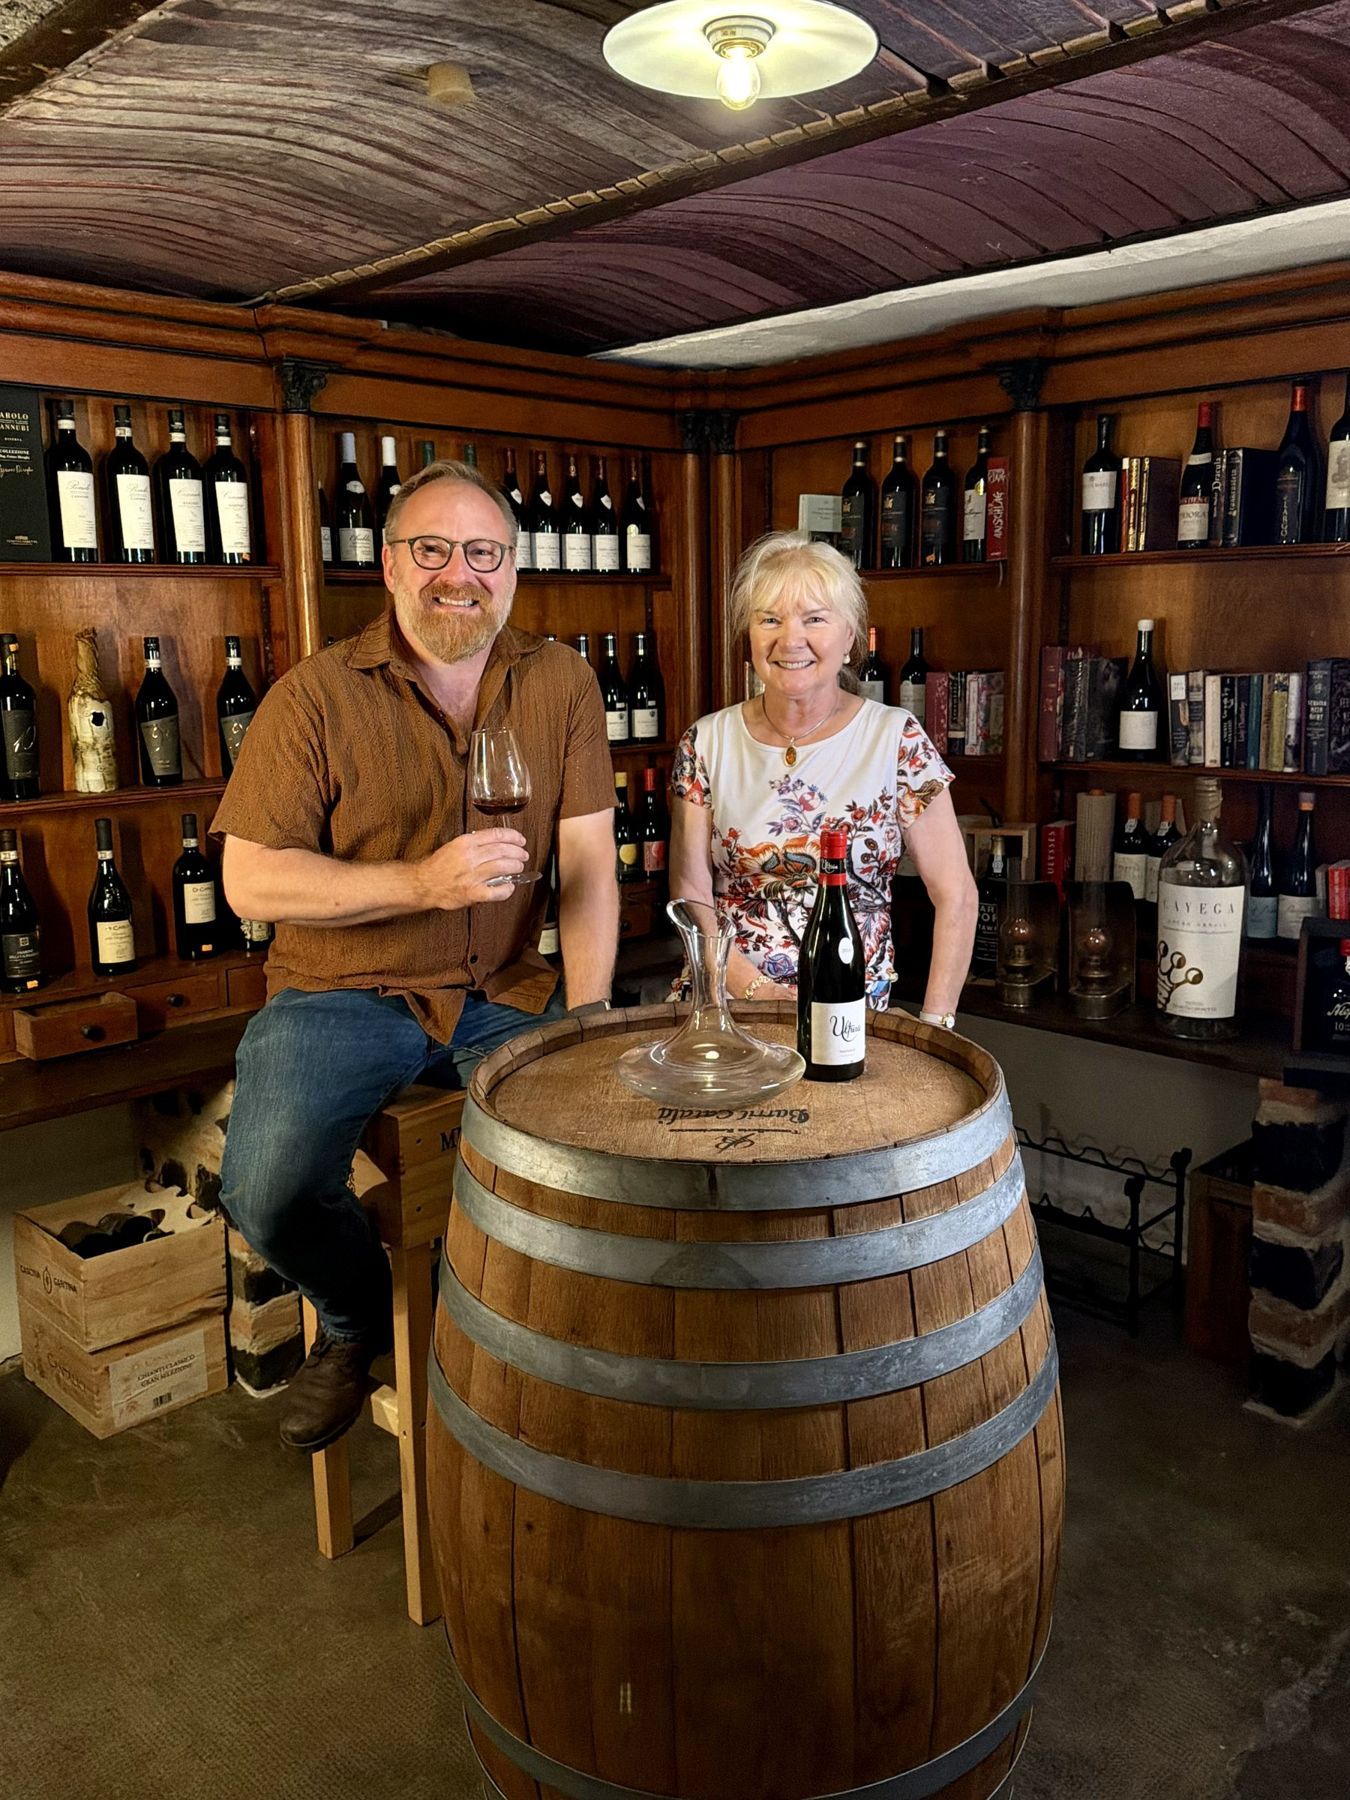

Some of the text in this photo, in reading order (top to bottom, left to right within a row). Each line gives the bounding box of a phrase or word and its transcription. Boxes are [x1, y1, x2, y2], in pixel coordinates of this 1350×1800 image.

[1211, 457, 1222, 492] Dracula
[992, 491, 1005, 538] ANSCHLAG
[1047, 831, 1056, 875] ULYSSES
[736, 1108, 810, 1124] Barril
[440, 1126, 462, 1152] M
